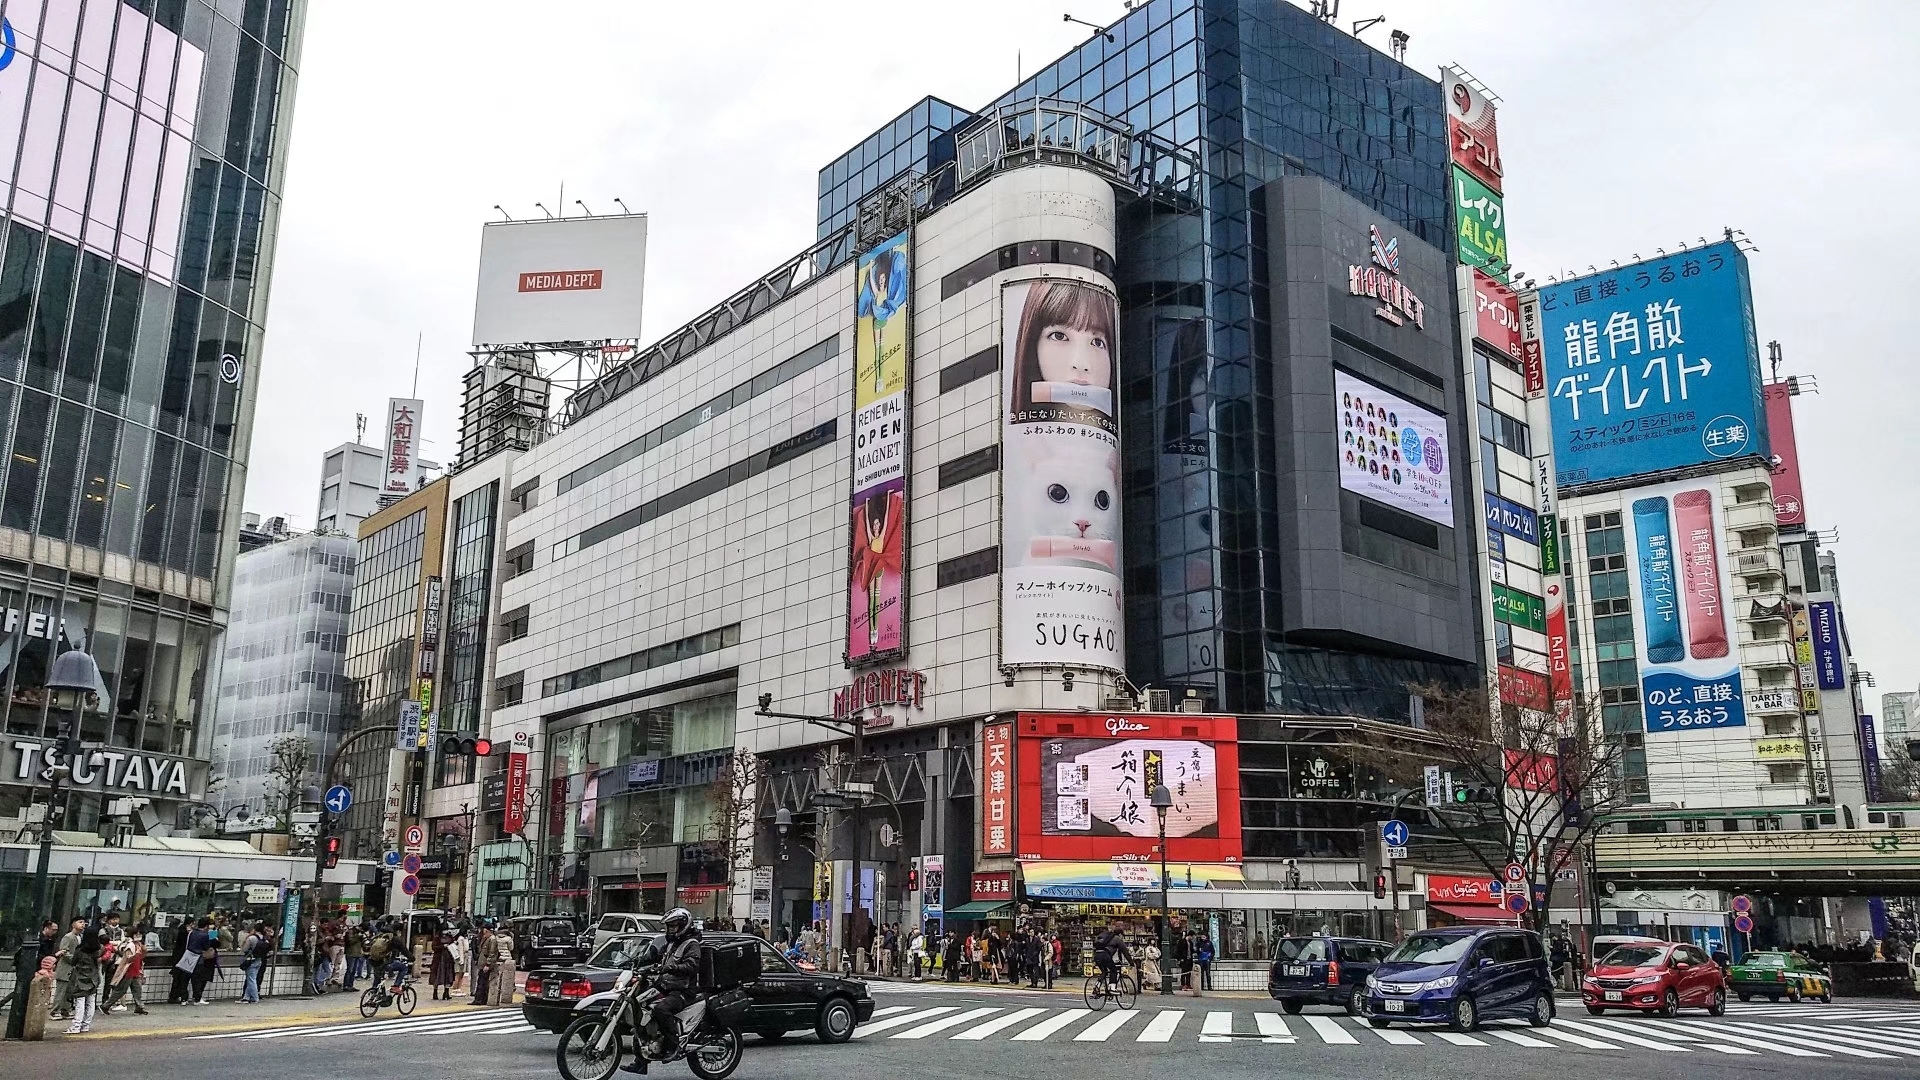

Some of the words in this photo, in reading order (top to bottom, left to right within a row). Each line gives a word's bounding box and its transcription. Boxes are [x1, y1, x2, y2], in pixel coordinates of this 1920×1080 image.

[1458, 127, 1502, 178] アコム
[1458, 178, 1501, 229] レイク
[1461, 215, 1505, 263] ALSA
[526, 274, 561, 288] MEDIA
[565, 273, 597, 287] DEPT.
[1349, 264, 1424, 330] MAGNET
[1476, 291, 1519, 333] アイフル
[1563, 298, 1684, 369] 龍角散
[1510, 342, 1522, 359] 8F
[1528, 353, 1541, 391] アイフル
[1553, 353, 1711, 420] ダイレクト
[858, 398, 901, 428] RENEWAL
[1569, 419, 1635, 444] スティック
[1639, 414, 1670, 429] ミント
[390, 406, 415, 475] 大和証券
[858, 418, 901, 449] OPEN
[1023, 426, 1076, 435] ふわふわの
[1705, 424, 1746, 448] 生薬
[857, 441, 901, 471] MAGNET
[857, 478, 864, 487] by
[865, 463, 900, 483] SHIBUYA109
[1538, 459, 1550, 512] レオパレス21
[1486, 502, 1533, 536] レオパレス21
[1648, 535, 1673, 622] 龍角散ダイレクト
[1690, 528, 1715, 617] 龍角散ダイレクト
[1016, 581, 1112, 597] スノーホイップクリーム
[1492, 592, 1507, 606] レイク
[1509, 598, 1526, 613] ALSA
[1533, 608, 1542, 620] 5F
[1819, 608, 1831, 643] MIZUHO
[1552, 636, 1566, 671] アコム
[1823, 649, 1835, 683] みずほ銀行
[834, 668, 926, 721] MAGNET
[1649, 683, 1741, 707] のど、直接、
[1751, 693, 1783, 703] DARTS
[1764, 701, 1783, 709] BAR
[405, 704, 420, 747] 渋谷駅前
[1105, 718, 1150, 736] Glico
[1659, 706, 1728, 727] うるおう
[987, 726, 1009, 742] 名物
[1811, 744, 1822, 752] 3F
[15, 741, 187, 794] TSUTAYA
[1301, 778, 1340, 787] COFFEE
[1316, 768, 1324, 776] H
[989, 744, 1006, 849] 天津甘栗
[1109, 750, 1146, 826] 箱入り娘
[1175, 760, 1192, 822] うまい。
[1871, 836, 1900, 850] JR
[974, 879, 1009, 893] 天津甘栗
